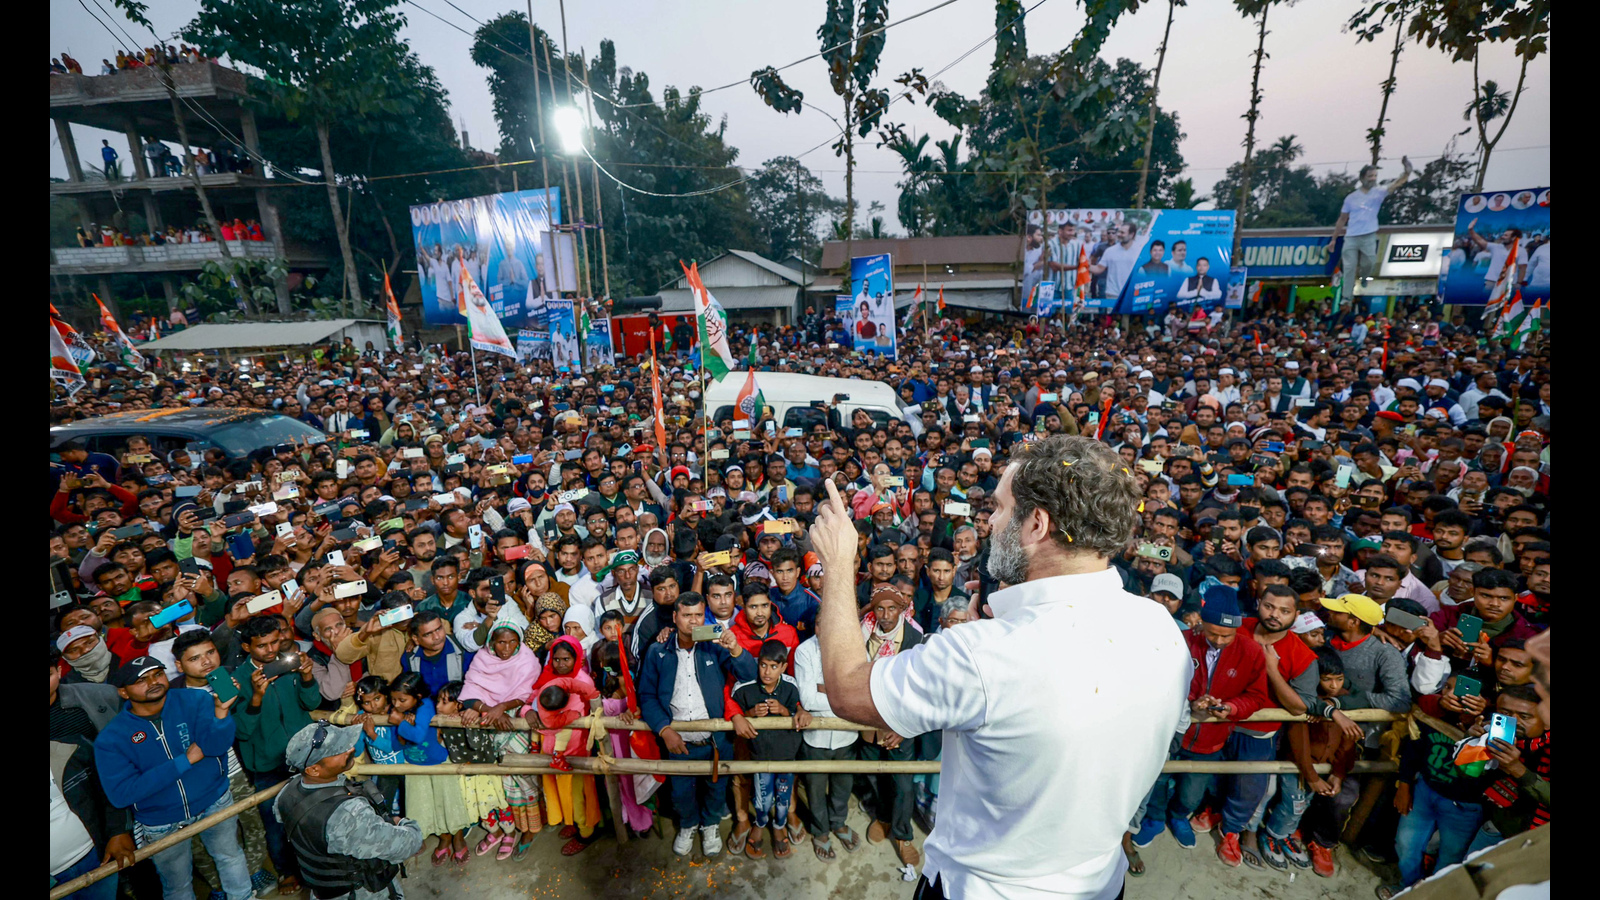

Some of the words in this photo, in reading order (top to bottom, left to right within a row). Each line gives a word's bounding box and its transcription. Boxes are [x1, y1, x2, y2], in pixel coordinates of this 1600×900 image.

[1238, 245, 1330, 266] UMINOUS
[1395, 246, 1422, 257] IVAS
[176, 722, 190, 751] FORC
